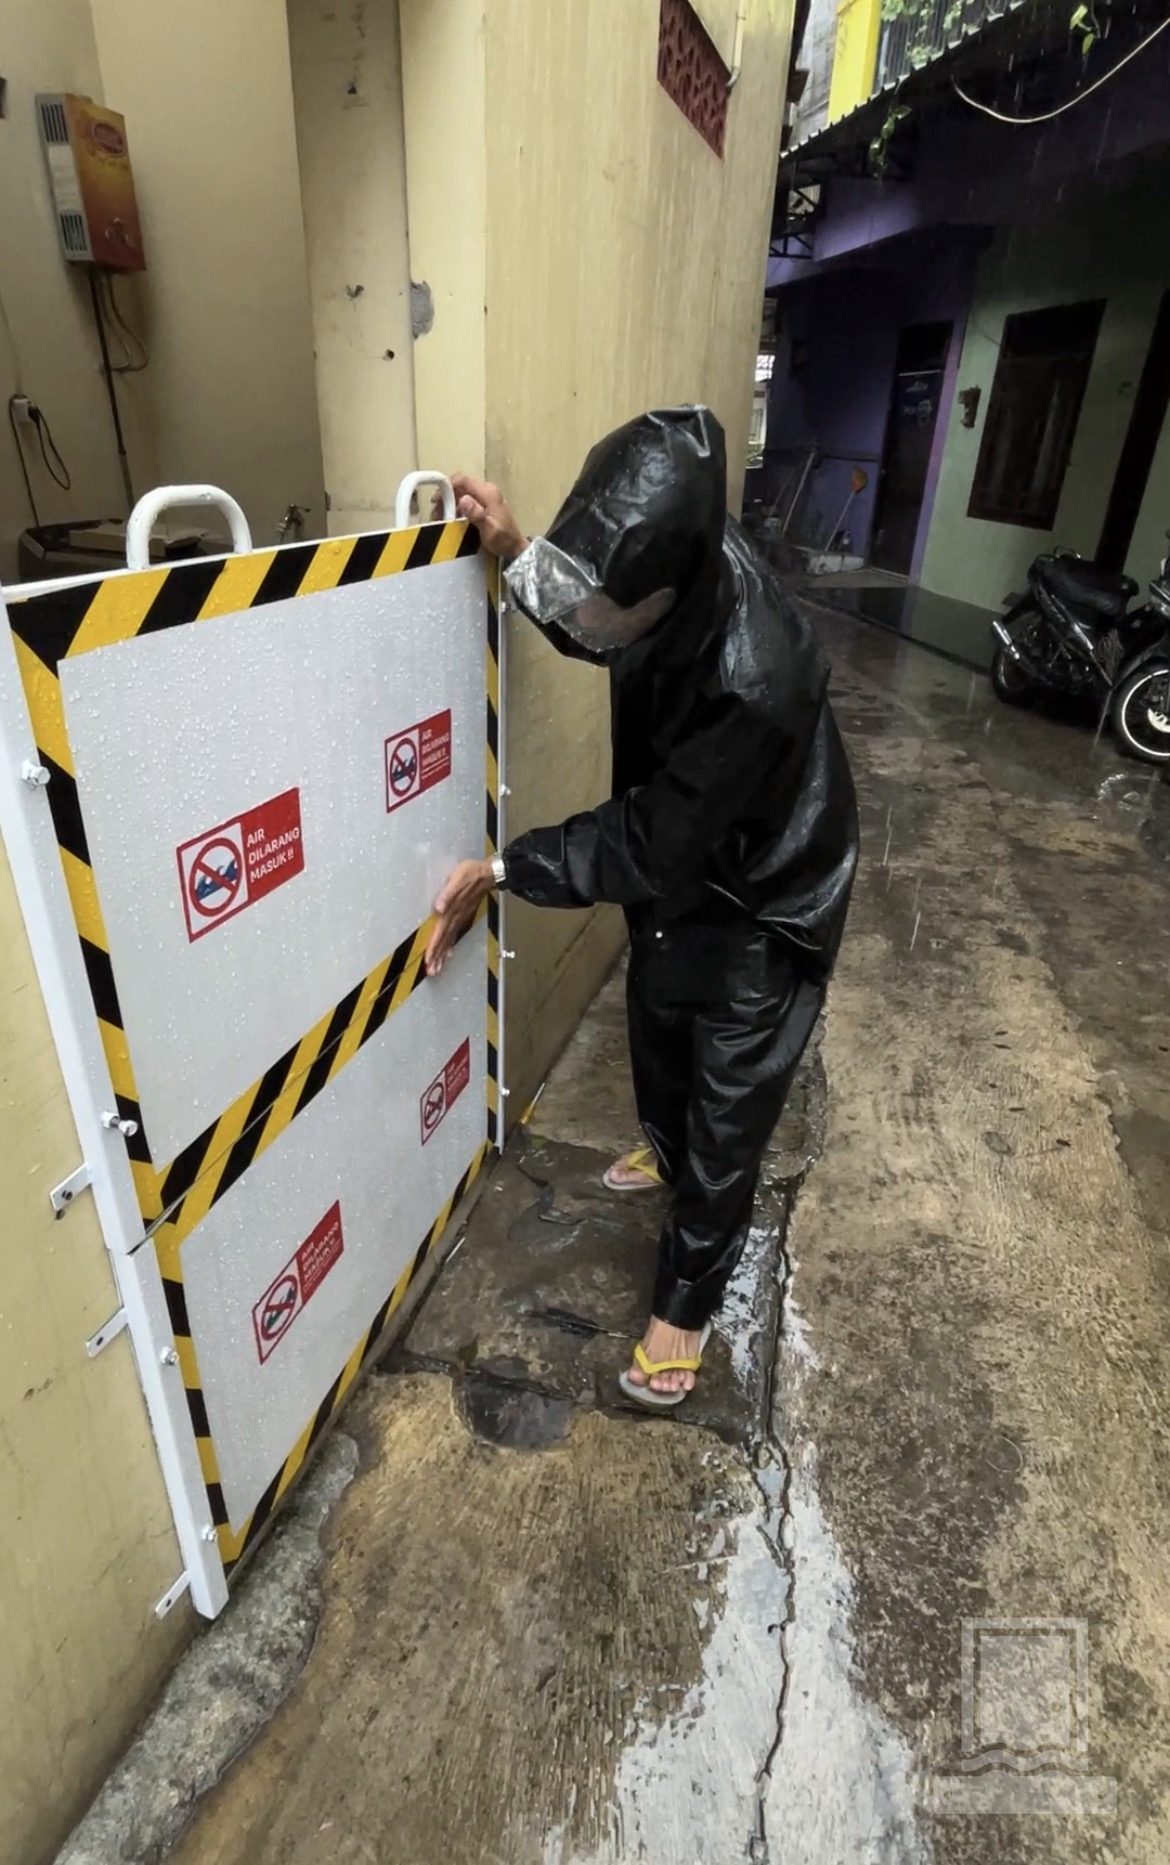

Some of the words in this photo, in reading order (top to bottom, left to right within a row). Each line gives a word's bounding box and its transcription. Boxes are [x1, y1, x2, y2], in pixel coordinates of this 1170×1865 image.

[247, 828, 265, 848] AIR
[248, 826, 300, 865] DILARANG
[250, 851, 287, 883] MASUK
